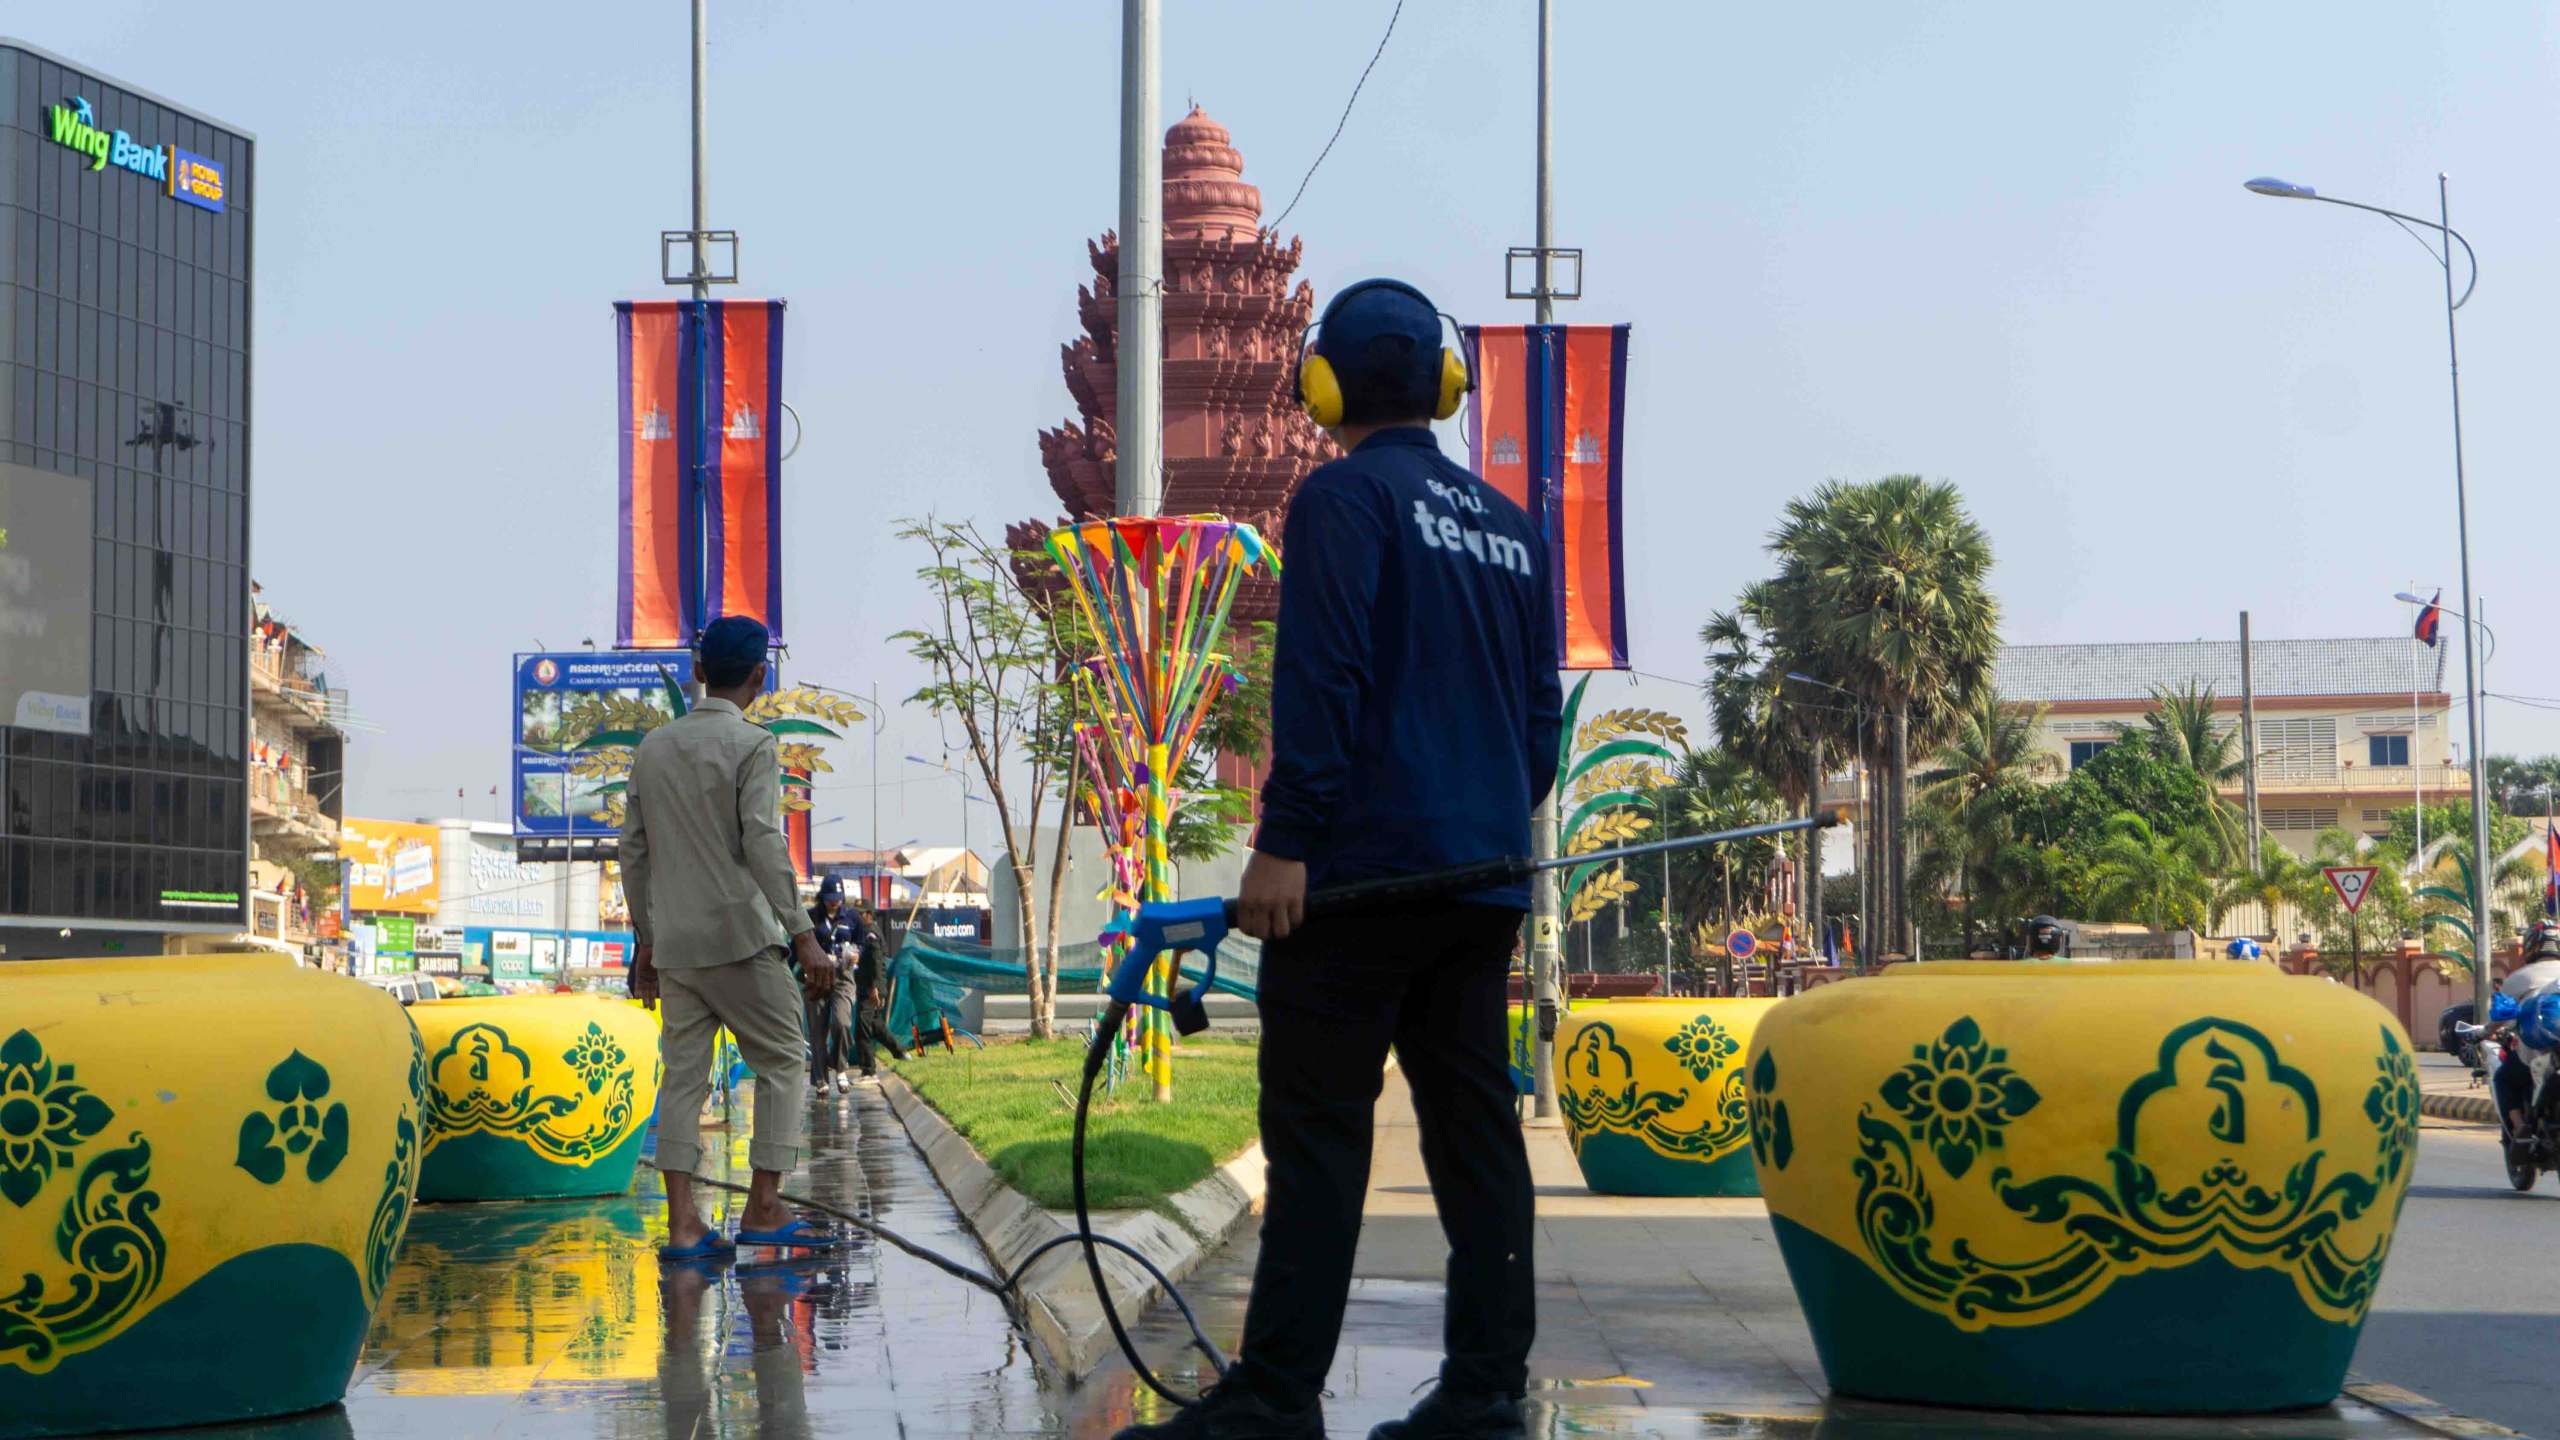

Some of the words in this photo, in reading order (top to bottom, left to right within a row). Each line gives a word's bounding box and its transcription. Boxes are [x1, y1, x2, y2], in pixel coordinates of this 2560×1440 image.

[54, 100, 110, 172] Wing
[110, 129, 168, 181] Bank
[191, 162, 221, 186] ROYAL
[191, 179, 224, 201] GROUP
[890, 919, 922, 929] tunai
[419, 957, 458, 972] SAMSUNG
